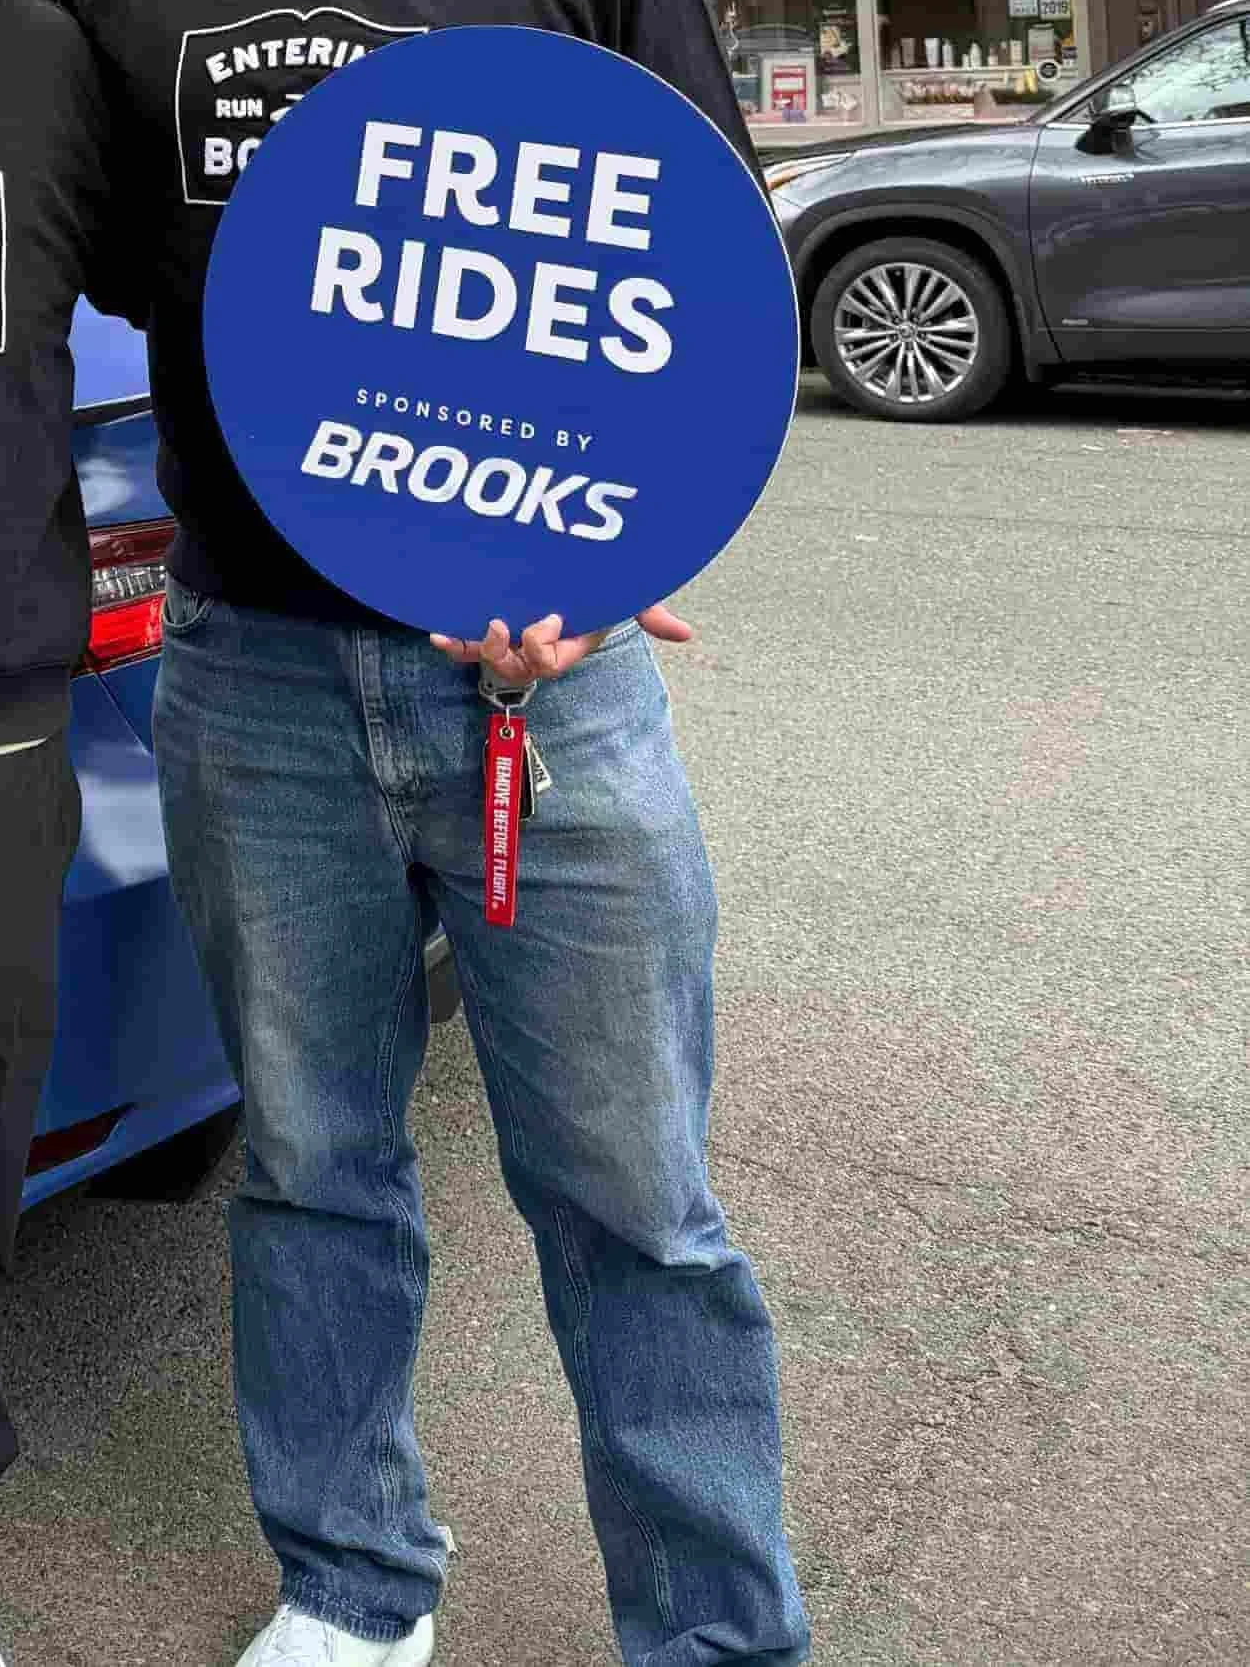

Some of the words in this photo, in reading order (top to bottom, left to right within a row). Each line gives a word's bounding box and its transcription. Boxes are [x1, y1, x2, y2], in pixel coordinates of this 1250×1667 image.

[206, 37, 374, 84] ENTERI
[215, 98, 263, 118] RUN
[355, 121, 661, 252] FREE
[310, 226, 675, 374] RIDES
[356, 388, 536, 440] SPONSORED
[555, 429, 593, 452] BY
[301, 420, 638, 542] BROOKS
[494, 756, 513, 808] REMOVE
[493, 809, 510, 856] BEFORE
